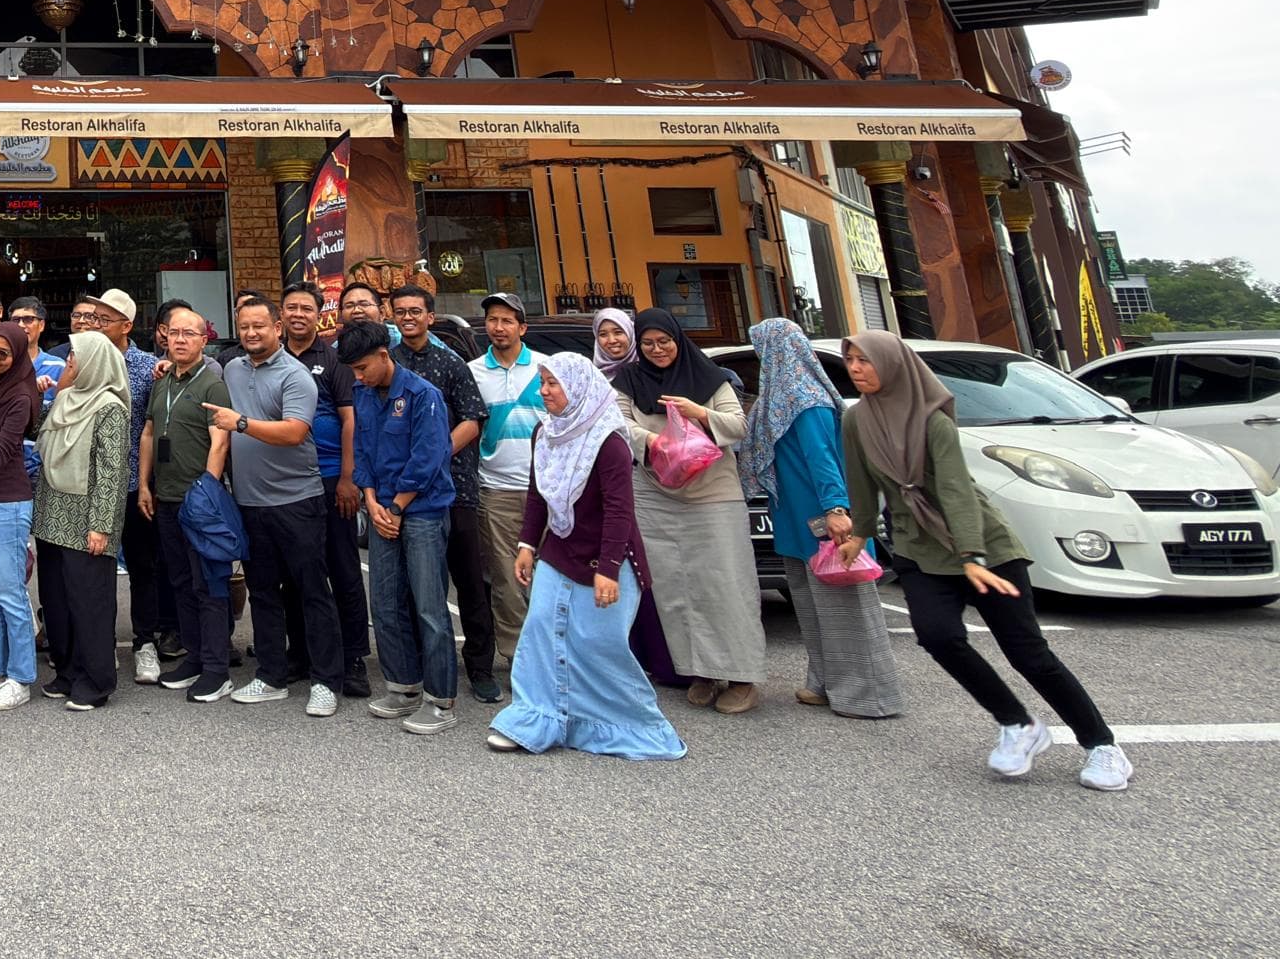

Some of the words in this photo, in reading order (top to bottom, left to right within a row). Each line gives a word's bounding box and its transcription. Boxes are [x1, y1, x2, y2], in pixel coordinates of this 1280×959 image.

[21, 118, 83, 132] Restoran
[86, 118, 146, 132] Alkhalifa
[218, 118, 281, 132] Restoran
[283, 118, 342, 132] Alkhalifa
[459, 120, 519, 134] Restoran
[523, 120, 580, 134] Alkhalifa
[660, 121, 720, 135] Restoran
[723, 121, 780, 135] Alkhalifa
[856, 122, 916, 136] Restoran
[920, 122, 976, 136] Alkhalifa
[8, 200, 39, 208] WELCOME
[1200, 530, 1225, 541] AGY
[1227, 530, 1252, 541] 1771
